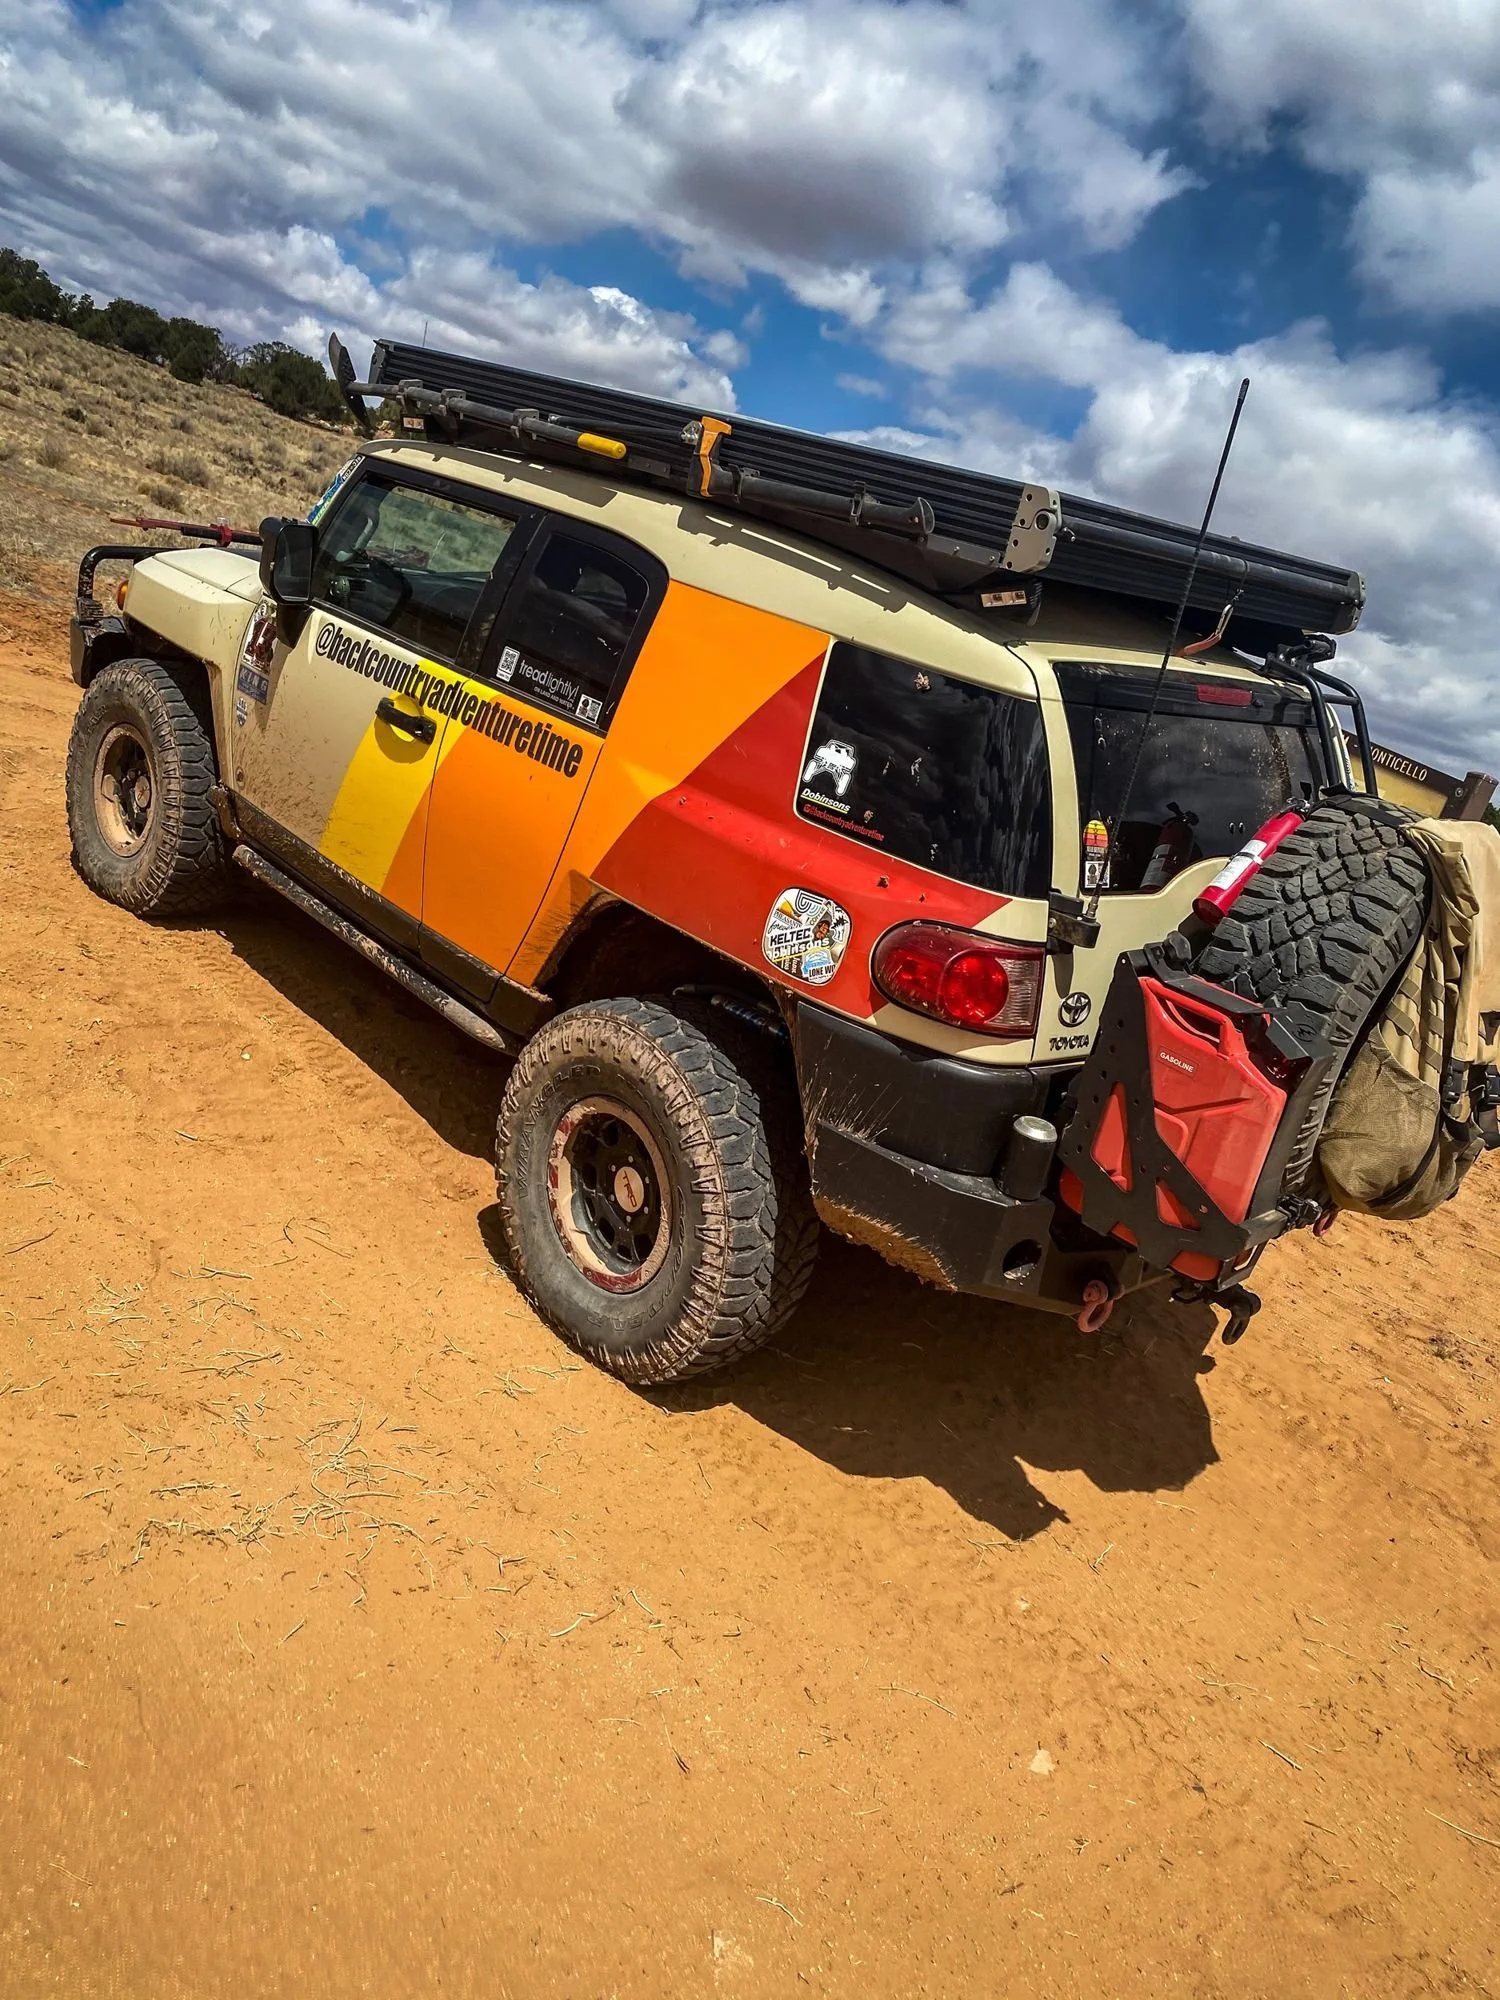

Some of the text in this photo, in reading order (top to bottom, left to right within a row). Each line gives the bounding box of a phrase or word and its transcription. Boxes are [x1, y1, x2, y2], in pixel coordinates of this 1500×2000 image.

[316, 622, 583, 778] @backcountryadventuretime
[1371, 745, 1428, 782] ONTICELLO
[802, 788, 851, 812] Dobinsons
[770, 927, 811, 947] KELTEC
[1049, 1035, 1090, 1052] TOYOTA
[1160, 1052, 1194, 1073] GASOLINE
